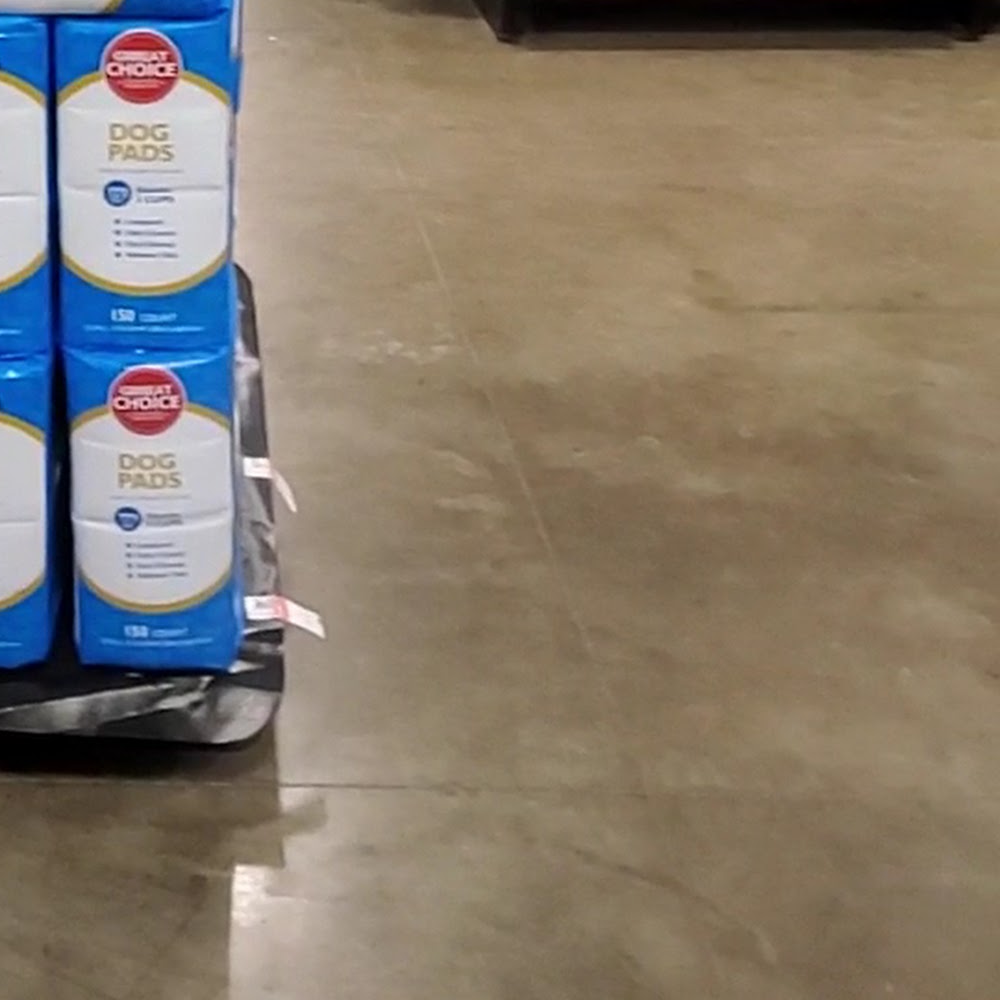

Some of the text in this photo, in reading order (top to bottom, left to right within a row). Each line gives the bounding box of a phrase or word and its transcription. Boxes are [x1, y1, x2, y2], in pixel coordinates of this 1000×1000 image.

[112, 51, 169, 62] GREAT
[106, 62, 178, 77] CHOICE
[109, 123, 169, 141] DOG
[108, 144, 175, 162] PADS
[110, 308, 136, 322] 150
[118, 384, 172, 396] GREAT
[112, 395, 182, 410] CHOICE
[118, 453, 177, 471] DOG
[118, 472, 183, 490] PADS
[124, 625, 149, 638] 150
